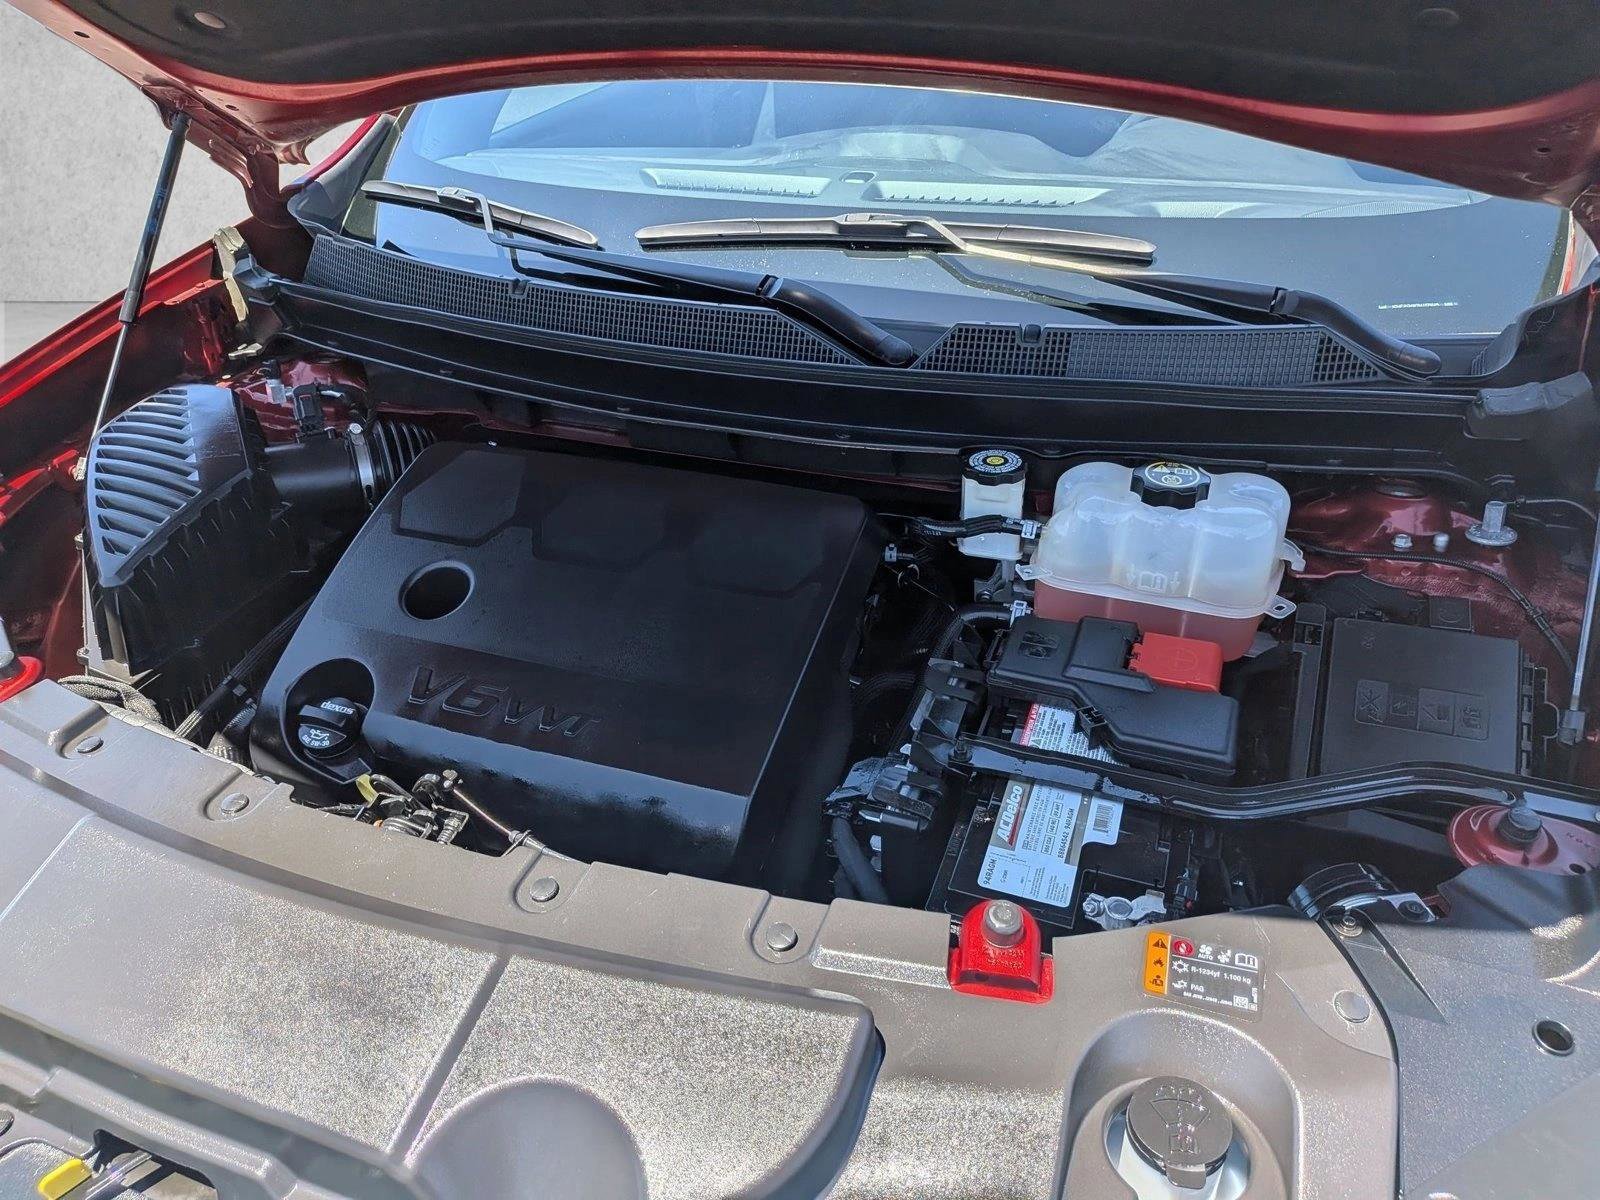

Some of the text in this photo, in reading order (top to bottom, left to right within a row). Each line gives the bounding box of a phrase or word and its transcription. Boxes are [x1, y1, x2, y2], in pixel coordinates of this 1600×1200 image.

[409, 664, 509, 717] V6
[320, 701, 353, 715] dexos
[996, 785, 1023, 842] ACDelco
[1064, 808, 1074, 830] 94RAGM
[983, 858, 997, 885] 94RAGM
[1191, 965, 1251, 984] R-1234yf 1.100 kg
